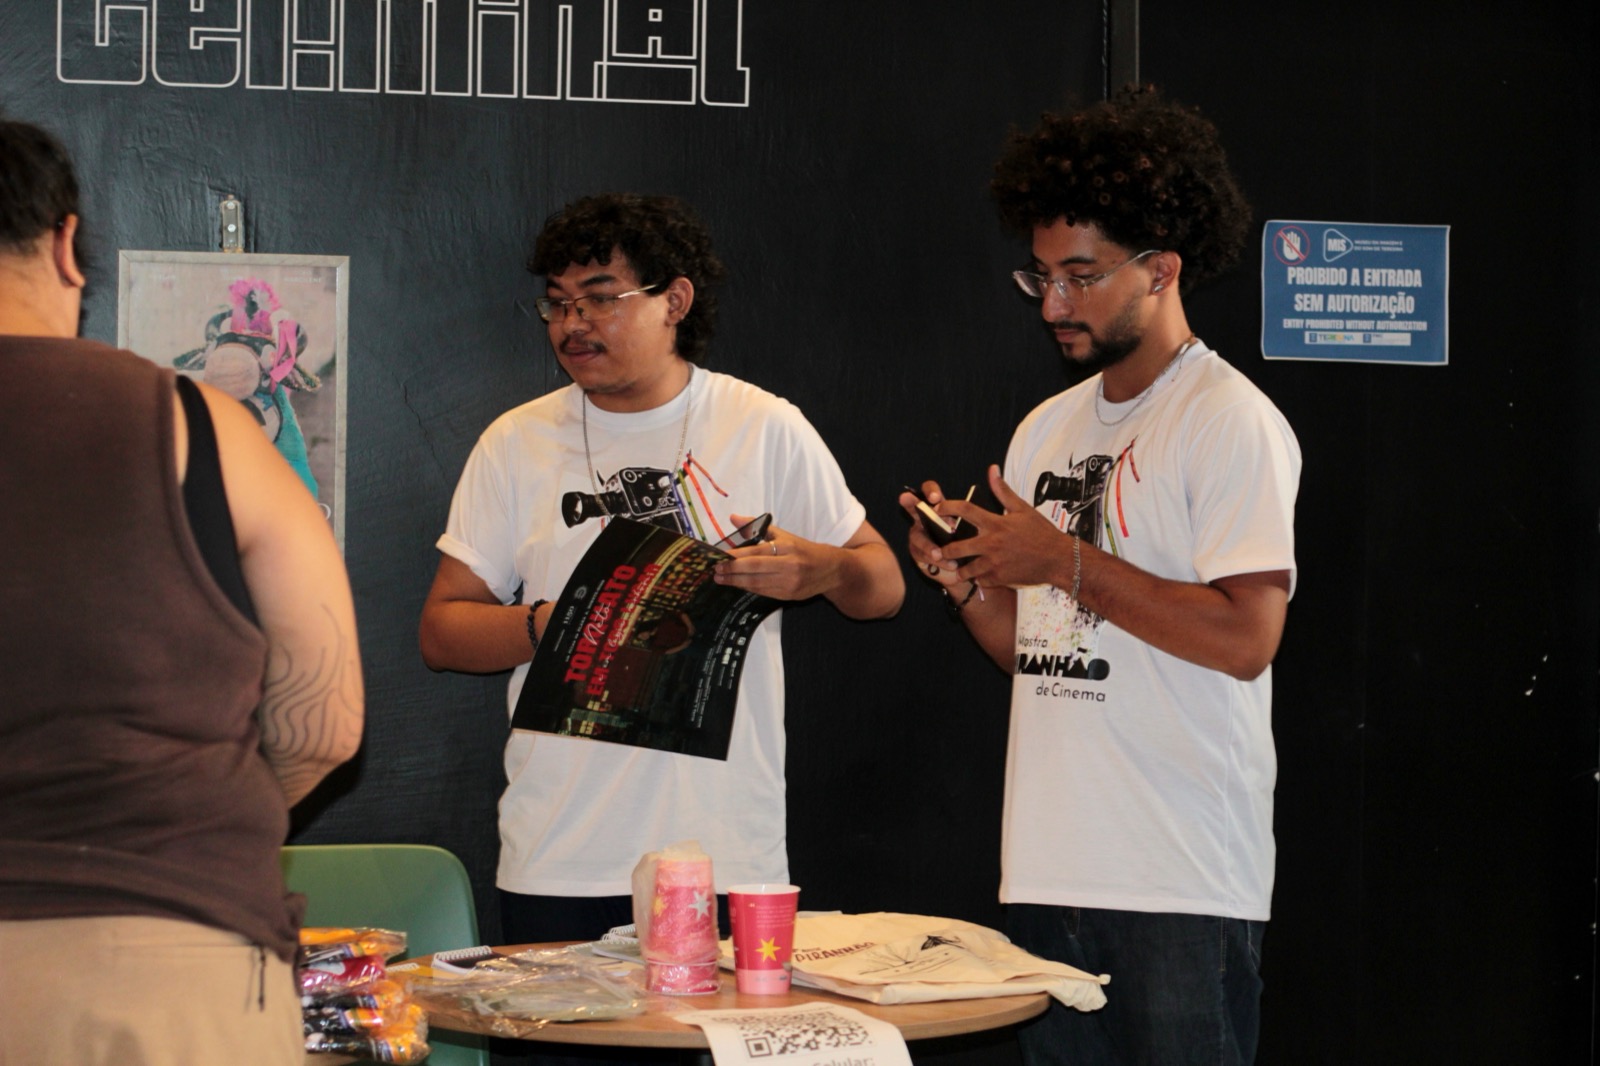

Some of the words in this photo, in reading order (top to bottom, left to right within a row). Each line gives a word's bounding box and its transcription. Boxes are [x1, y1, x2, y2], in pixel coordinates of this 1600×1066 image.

[1327, 238, 1347, 252] MIS
[1287, 266, 1348, 287] PROIBIDO
[1351, 267, 1360, 287] A
[1363, 267, 1422, 288] ENTRADA
[1294, 293, 1324, 313] SEM
[1326, 291, 1415, 319] AUTORIZAÇÃO
[1283, 318, 1304, 329] ENTRY
[1305, 319, 1345, 330] PROHIBITED
[1345, 320, 1376, 331] WITHOUT
[1035, 681, 1049, 697] de
[1051, 682, 1106, 702] Cinema
